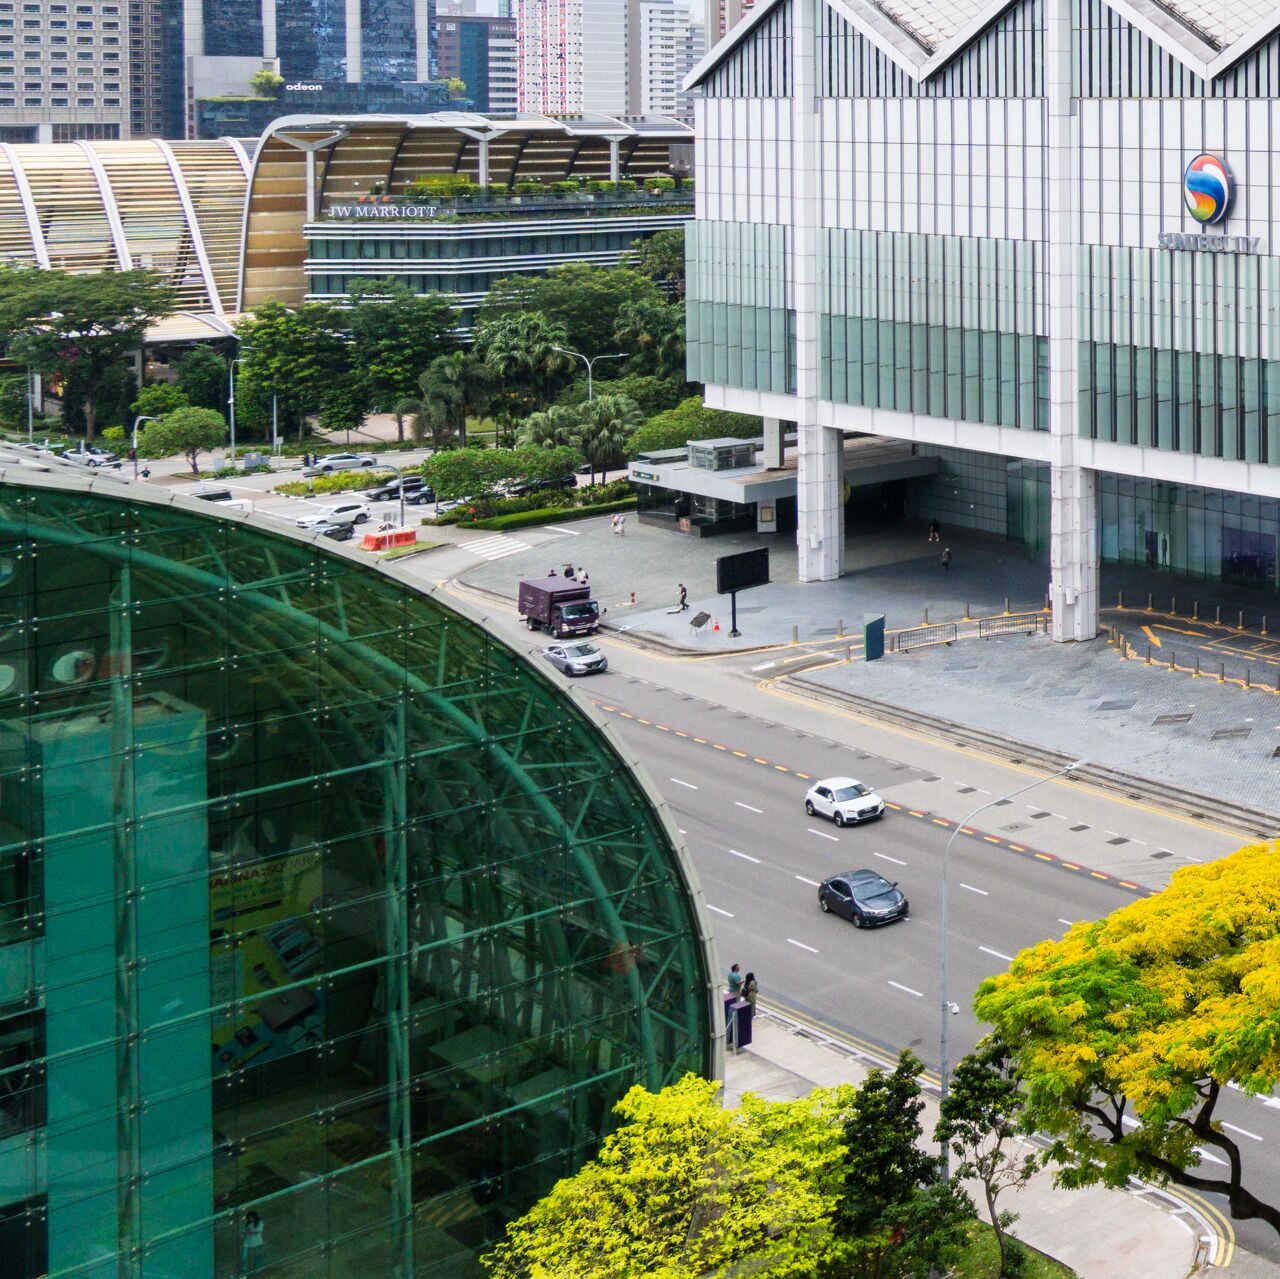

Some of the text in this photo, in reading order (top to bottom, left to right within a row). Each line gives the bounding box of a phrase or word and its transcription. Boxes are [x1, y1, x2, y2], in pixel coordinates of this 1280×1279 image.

[286, 81, 322, 90] odeon
[328, 206, 437, 217] JW MARRIOTT
